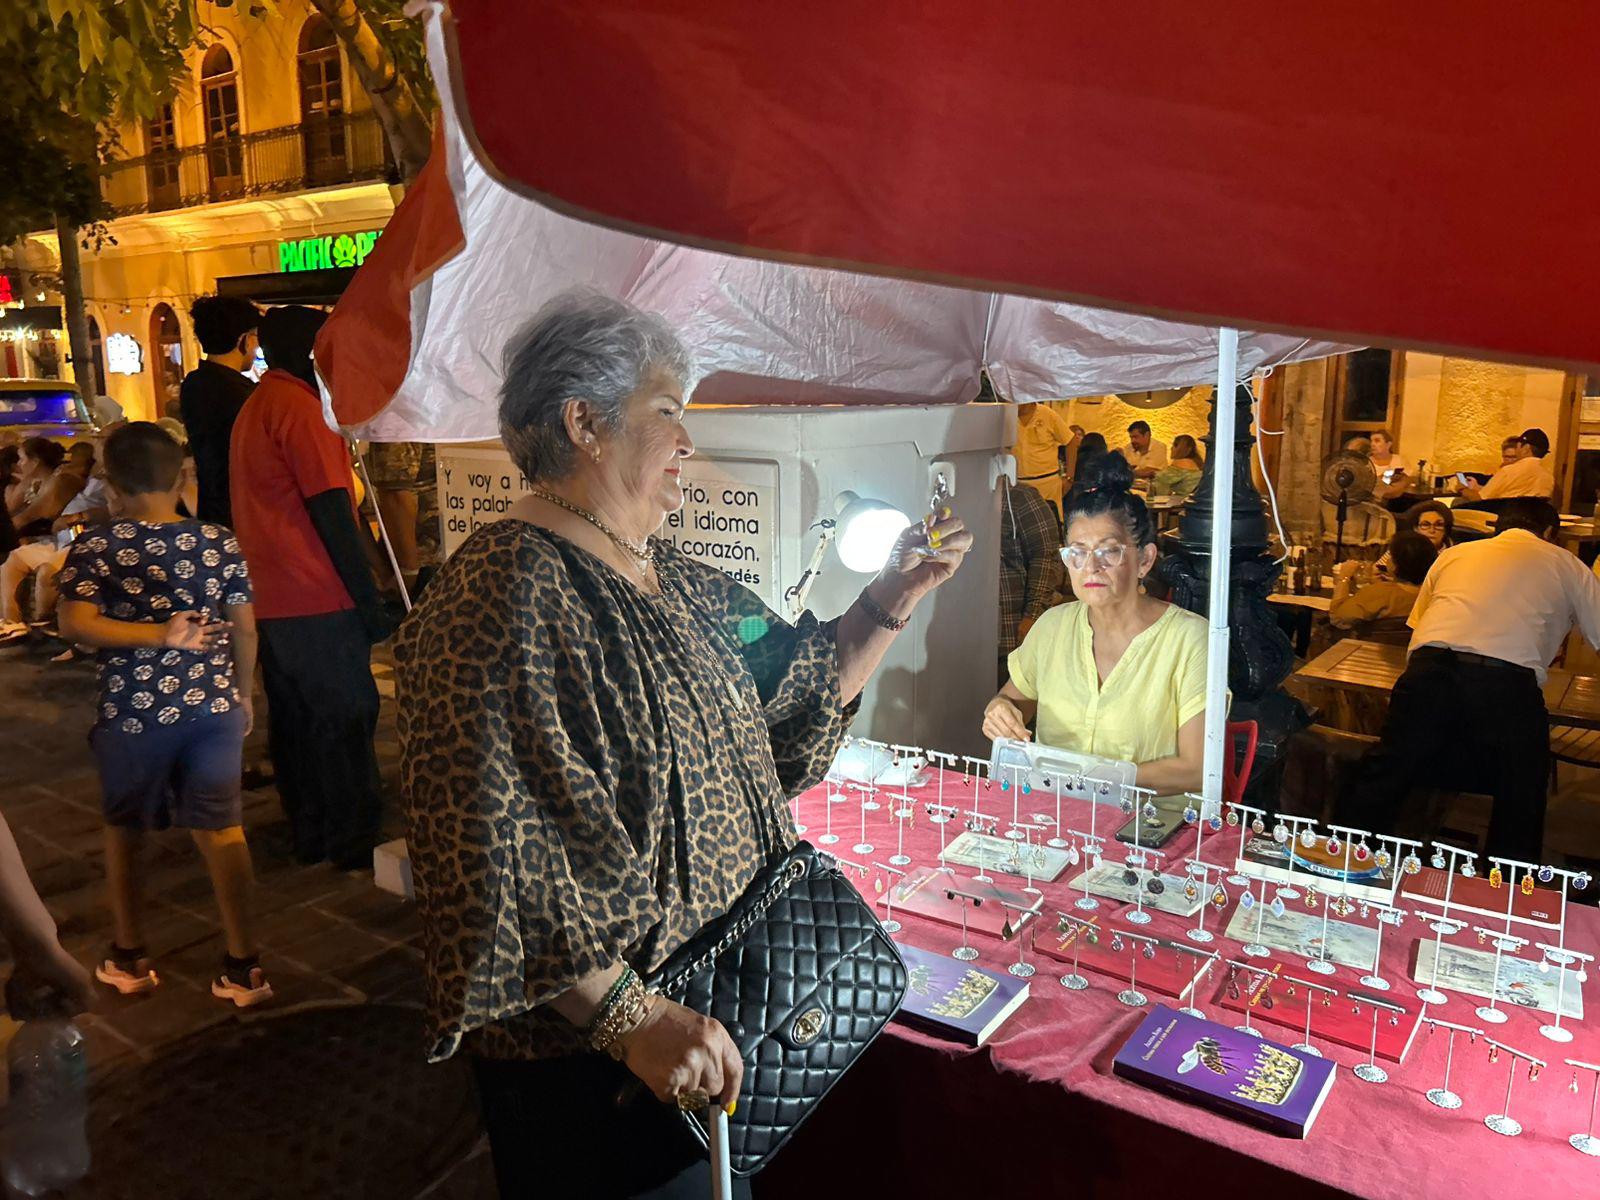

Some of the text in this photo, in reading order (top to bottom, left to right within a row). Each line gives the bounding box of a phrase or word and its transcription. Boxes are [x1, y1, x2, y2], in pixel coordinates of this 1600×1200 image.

[279, 236, 334, 273] PACIFIC
[444, 468, 451, 485] Y
[468, 473, 492, 494] voy
[500, 475, 511, 490] a
[682, 482, 709, 504] rio,
[722, 490, 758, 507] con
[446, 491, 465, 510] las
[668, 509, 684, 528] el
[695, 510, 759, 535] idioma
[448, 515, 466, 533] de
[470, 516, 487, 533] lo
[681, 540, 760, 562] corazón.
[719, 566, 760, 584] dés
